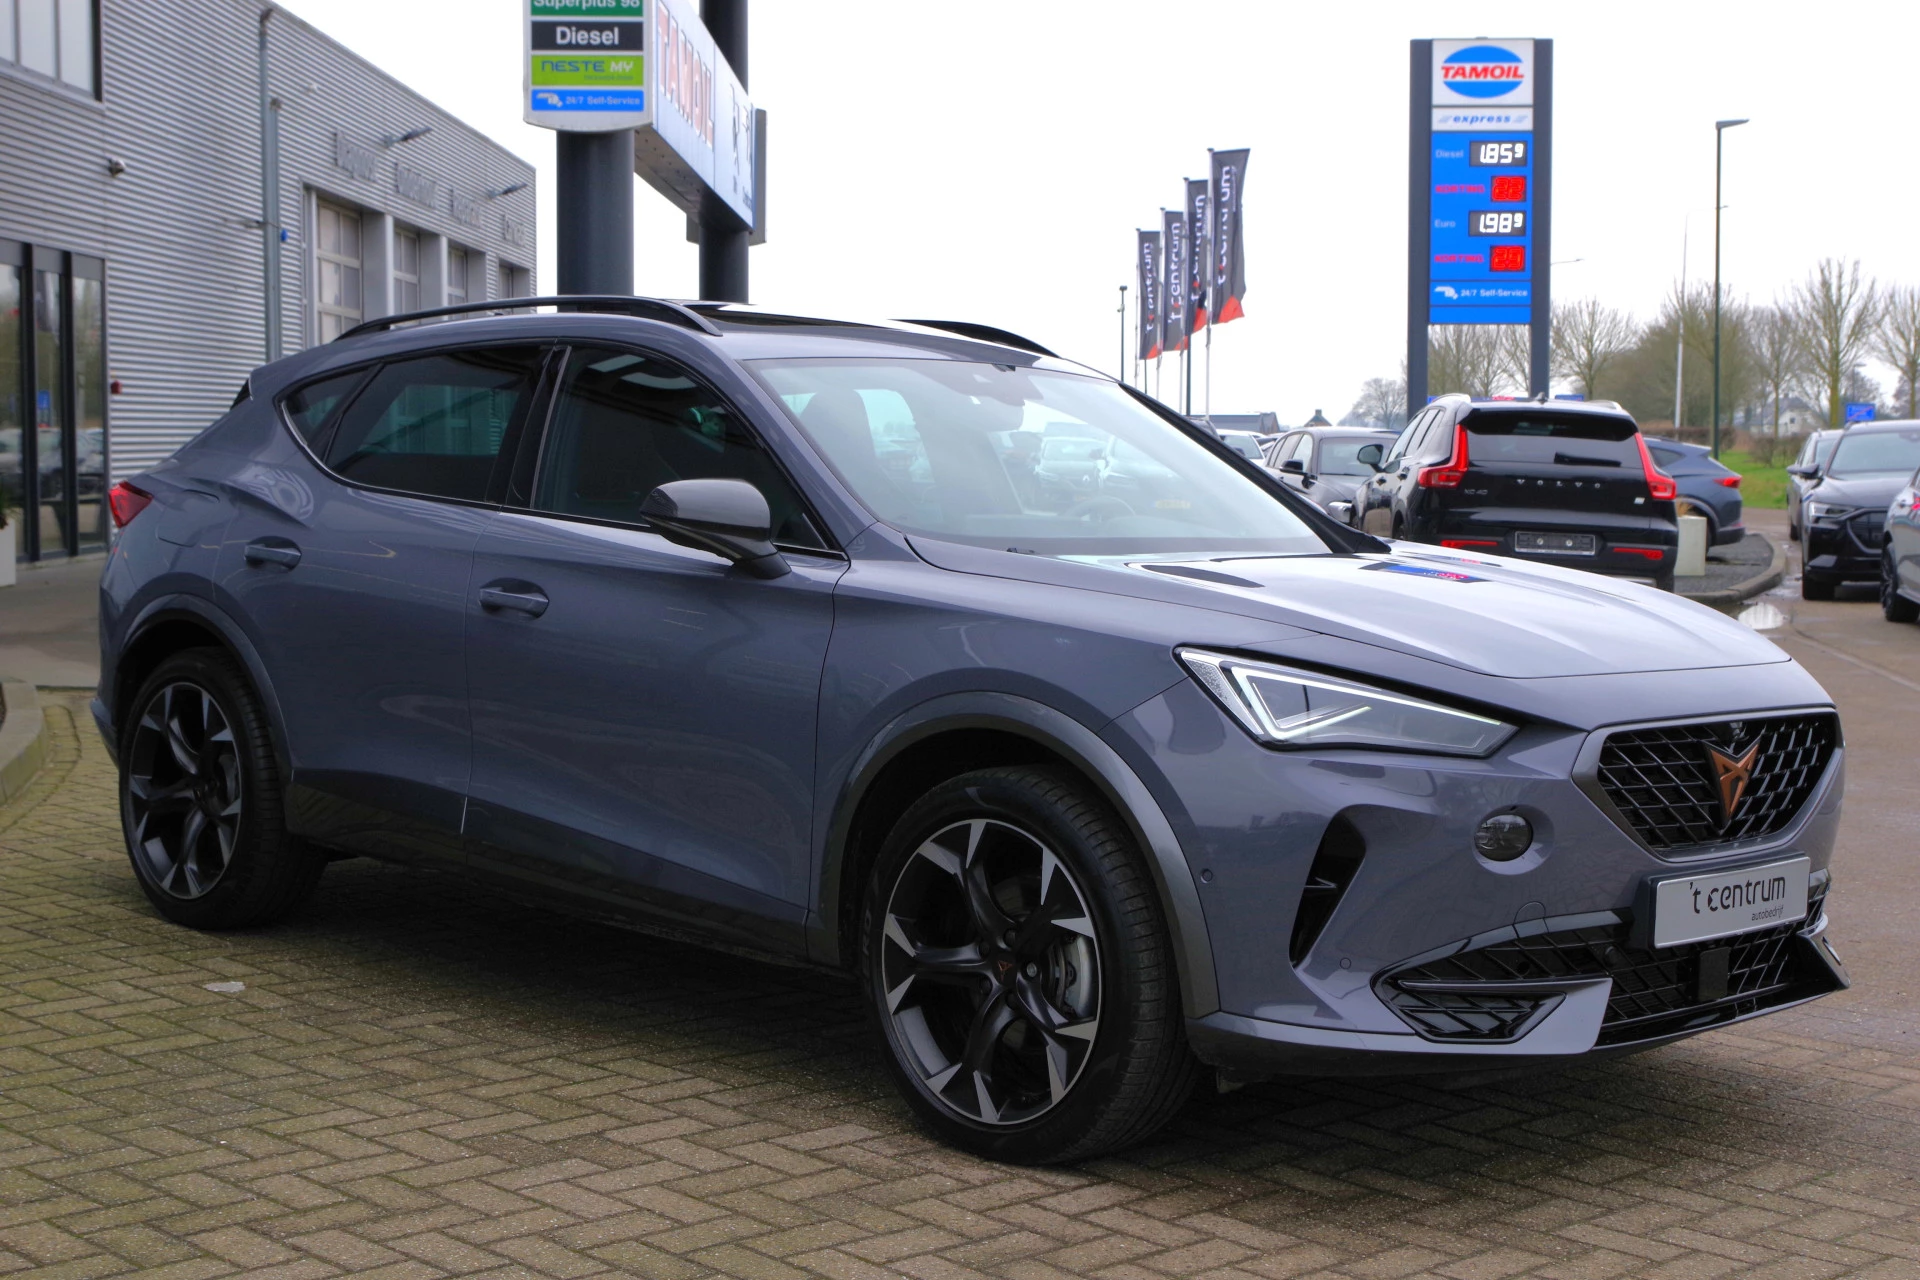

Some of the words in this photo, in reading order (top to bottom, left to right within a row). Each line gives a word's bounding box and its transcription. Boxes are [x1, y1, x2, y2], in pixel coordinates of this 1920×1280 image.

[556, 26, 619, 45] Diesel
[540, 60, 605, 73] NESTE
[610, 61, 634, 73] MY
[1441, 65, 1524, 79] TAMOIL
[658, 0, 714, 152] TAMOIL
[1453, 115, 1511, 125] express
[1436, 149, 1464, 158] Diesel
[1492, 176, 1525, 201] 22
[1435, 219, 1456, 228] Euro
[1170, 222, 1181, 308] centrum
[1143, 242, 1155, 320] entrum
[1461, 289, 1477, 297] 24/7
[1480, 288, 1528, 298] Self-Service
[1517, 479, 1600, 489] VOLVO
[1689, 881, 1701, 914] 't
[1707, 876, 1786, 912] centrum
[1751, 904, 1784, 921] autobedrijf
